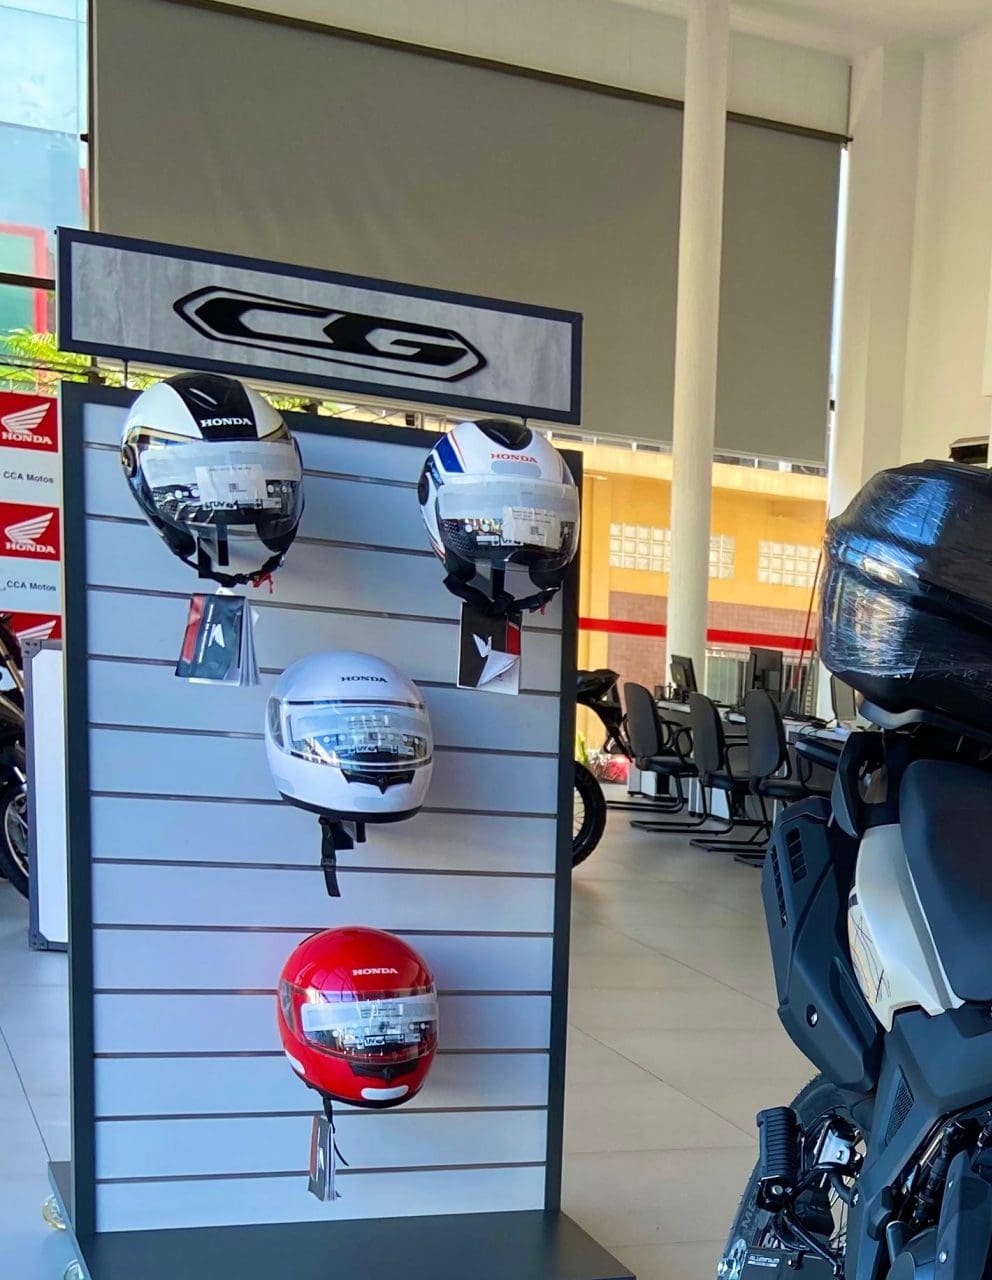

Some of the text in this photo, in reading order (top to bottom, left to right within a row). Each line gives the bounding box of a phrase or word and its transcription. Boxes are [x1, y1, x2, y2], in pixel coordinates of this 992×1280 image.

[195, 297, 468, 366] CG
[200, 417, 253, 427] HONDA
[1, 431, 53, 445] HONDA
[491, 453, 538, 463] HONDA
[3, 471, 54, 484] CCA Motos
[5, 541, 56, 554] HONDA
[6, 580, 57, 592] CCA Motos
[341, 675, 388, 683] HONDA
[352, 967, 399, 976] HONDA
